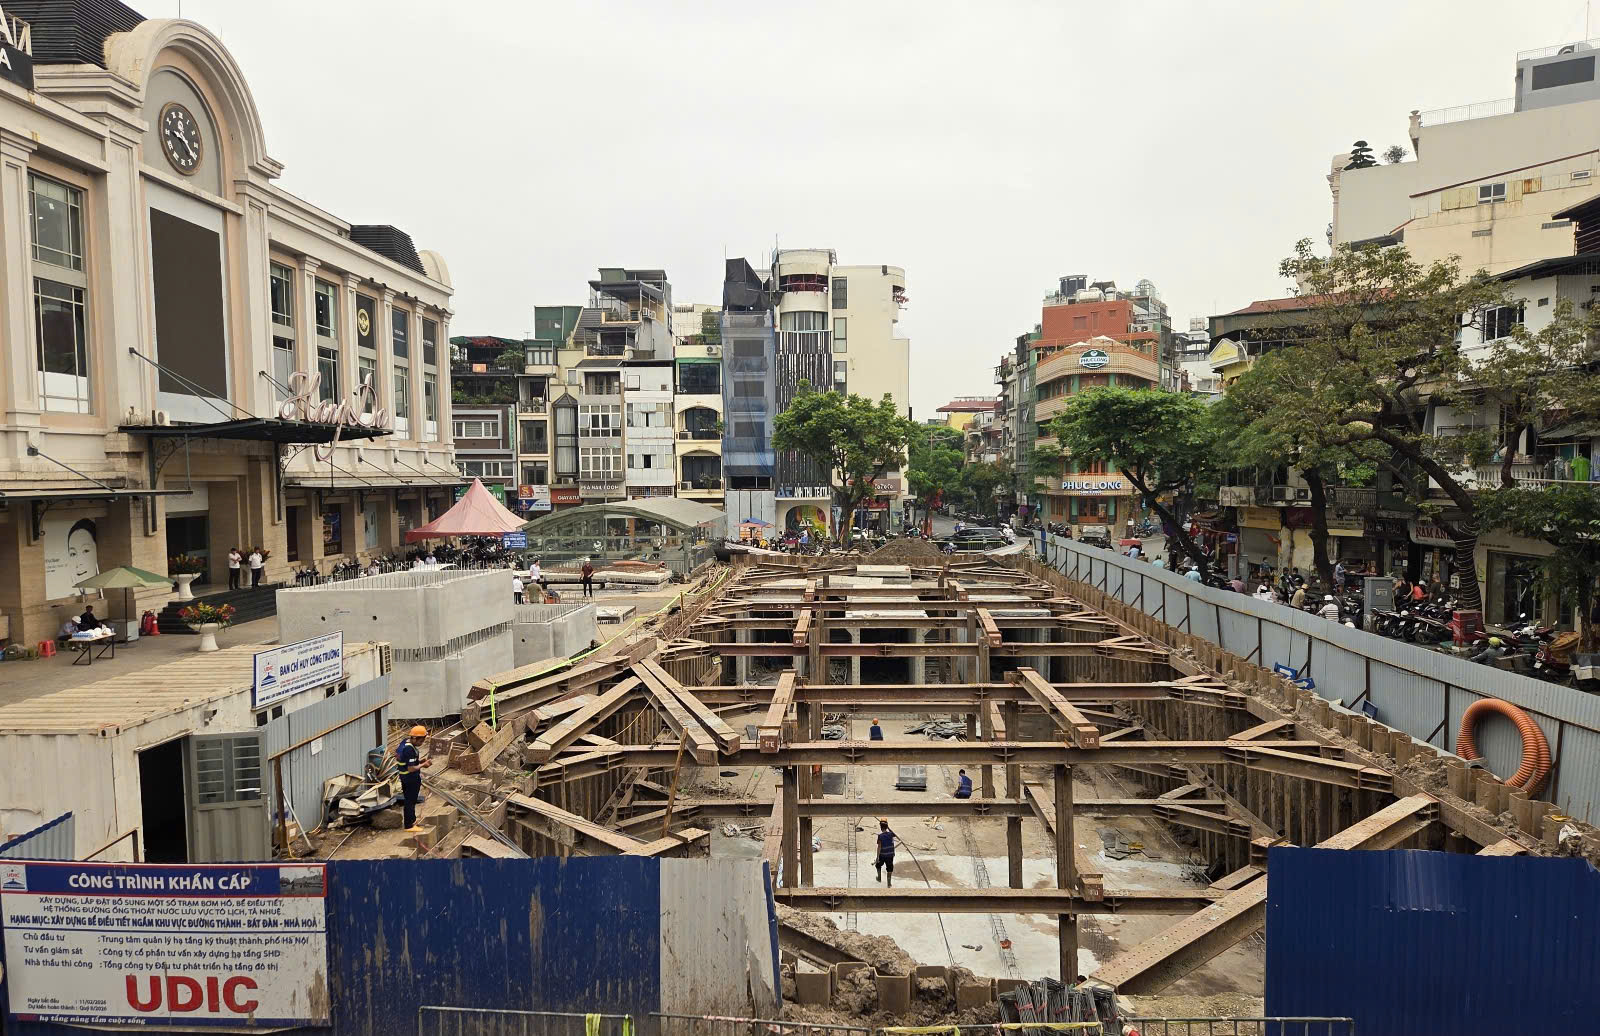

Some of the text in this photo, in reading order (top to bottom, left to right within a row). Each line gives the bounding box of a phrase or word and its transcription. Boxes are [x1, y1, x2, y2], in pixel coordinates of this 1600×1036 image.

[1092, 481, 1122, 490] LONG
[1416, 527, 1434, 538] NAM
[280, 664, 290, 676] BAN
[300, 658, 310, 670] HUY
[310, 654, 322, 666] CÔNG
[322, 648, 340, 662] TRƯỜNG
[69, 872, 250, 890] CÔNG TRÌNH KHẨN CẤP
[148, 898, 164, 907] MỘT
[166, 898, 176, 906] SỐ
[178, 900, 199, 908] TRẠM
[198, 908, 214, 916] VỰC
[10, 915, 30, 926] HẠNG
[32, 916, 50, 926] MỤC:
[52, 914, 64, 924] XÂY
[66, 916, 86, 926] DỰNG
[116, 915, 130, 926] TIẾT
[155, 918, 170, 927] KHU
[172, 918, 187, 928] VỰC
[188, 918, 214, 928] ĐƯỜNG
[216, 918, 242, 928] THÀNH
[248, 918, 262, 928] BÁT
[263, 918, 278, 928] ĐÀN
[284, 918, 300, 928] NHÀ
[23, 932, 38, 940] Chủ
[126, 936, 140, 944] tâm
[143, 936, 162, 945] quản
[164, 936, 172, 946] lý
[174, 937, 182, 946] hạ
[216, 937, 237, 946] thuật
[239, 937, 262, 945] thành
[36, 946, 48, 954] vấn
[51, 946, 70, 956] giám
[72, 946, 82, 954] sát
[103, 948, 122, 958] Công
[126, 950, 132, 958] ty
[178, 949, 192, 957] vấn
[194, 950, 206, 960] xây
[209, 950, 230, 960] dựng
[232, 950, 242, 958] hạ
[74, 960, 92, 970] công
[124, 962, 144, 970] công
[146, 963, 153, 972] ty
[183, 962, 200, 972] phát
[223, 963, 232, 972] hạ
[268, 963, 278, 972] thị
[126, 975, 258, 1013] UDIC
